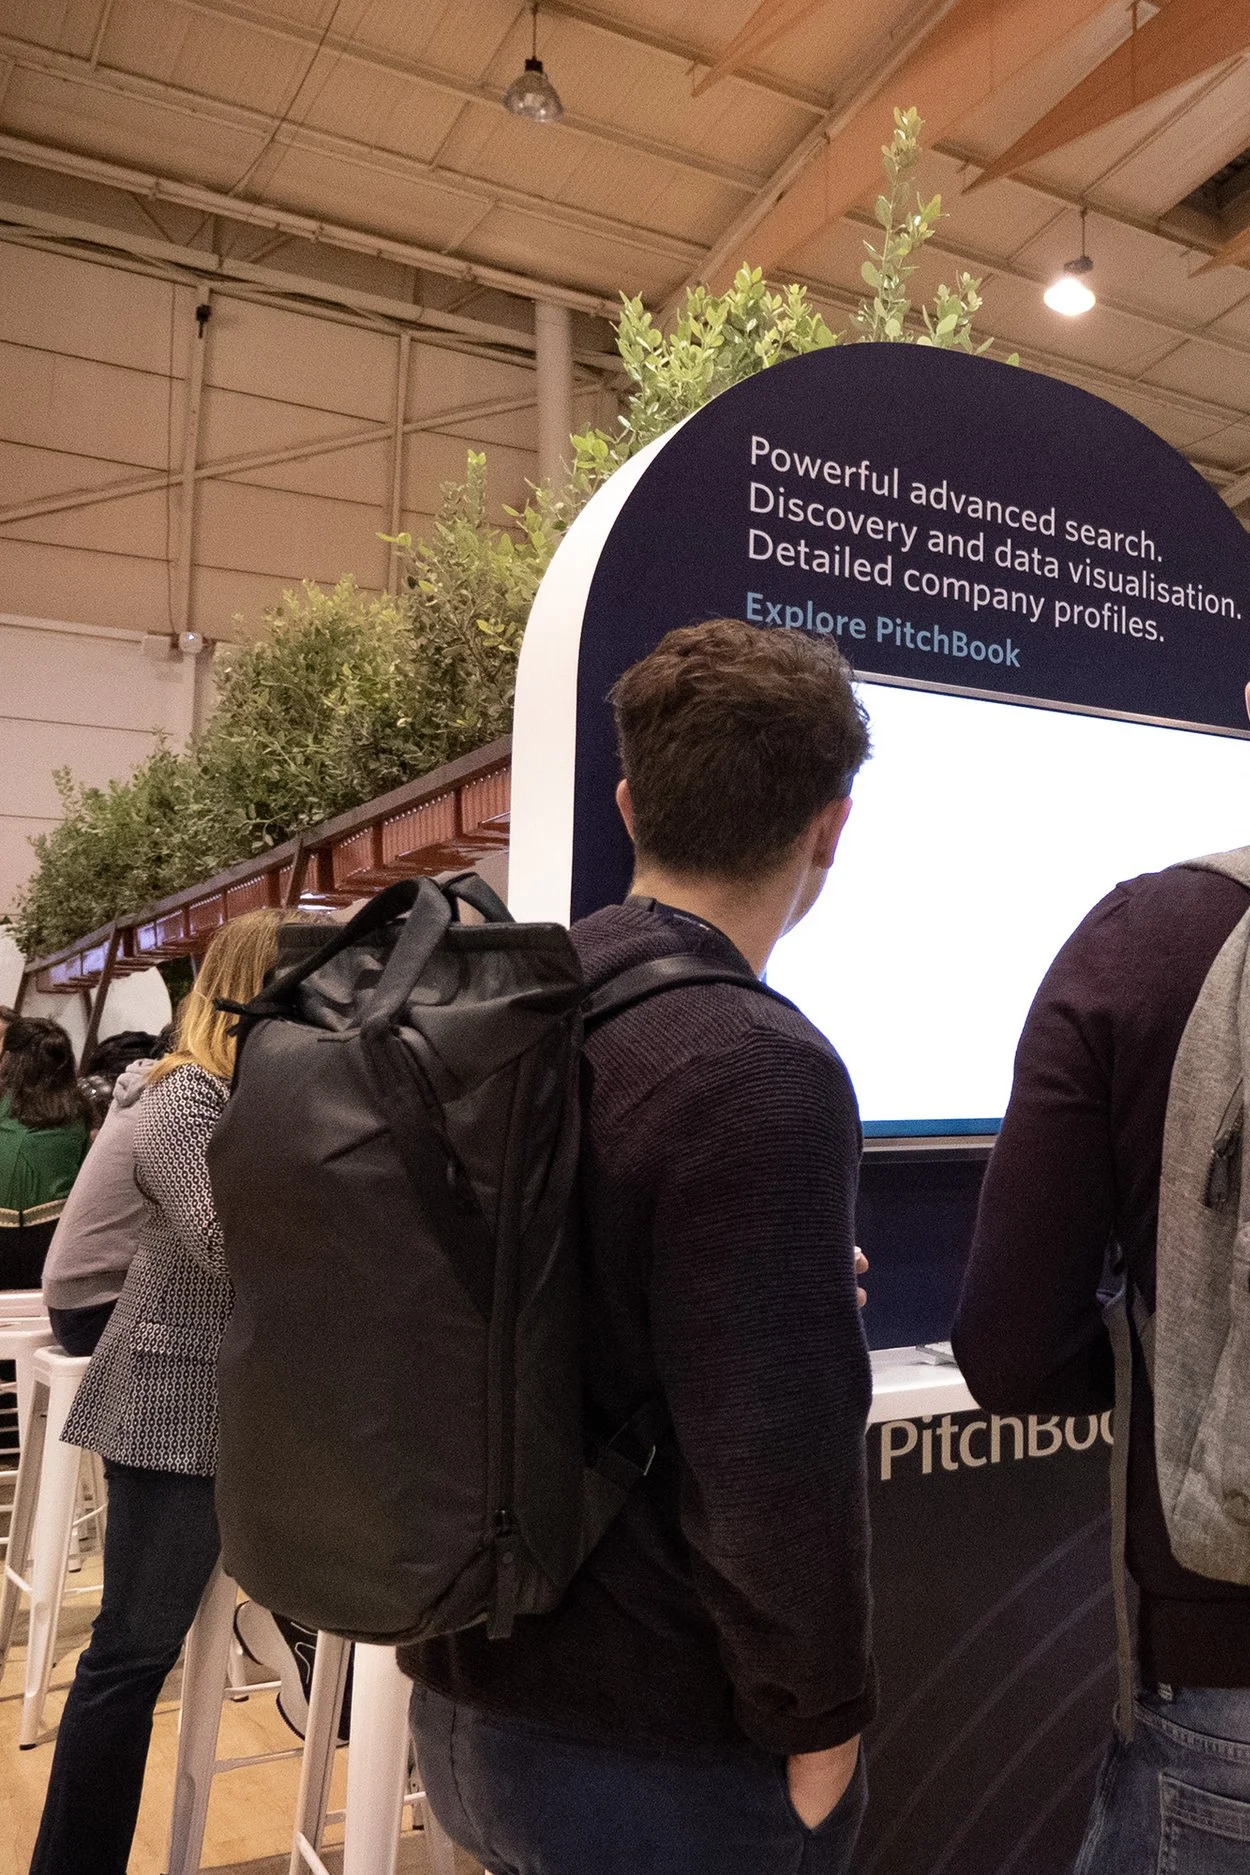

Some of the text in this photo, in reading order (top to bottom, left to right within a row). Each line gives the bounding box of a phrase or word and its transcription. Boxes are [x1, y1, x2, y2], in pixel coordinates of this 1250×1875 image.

[749, 481, 1242, 620] Discovery and data visualisation.
[750, 434, 1163, 563] Powerful advanced search.
[746, 591, 1021, 668] Explore PitchBook
[748, 528, 1165, 643] Detailed company profiles.
[880, 1408, 1114, 1481] PitchBo
